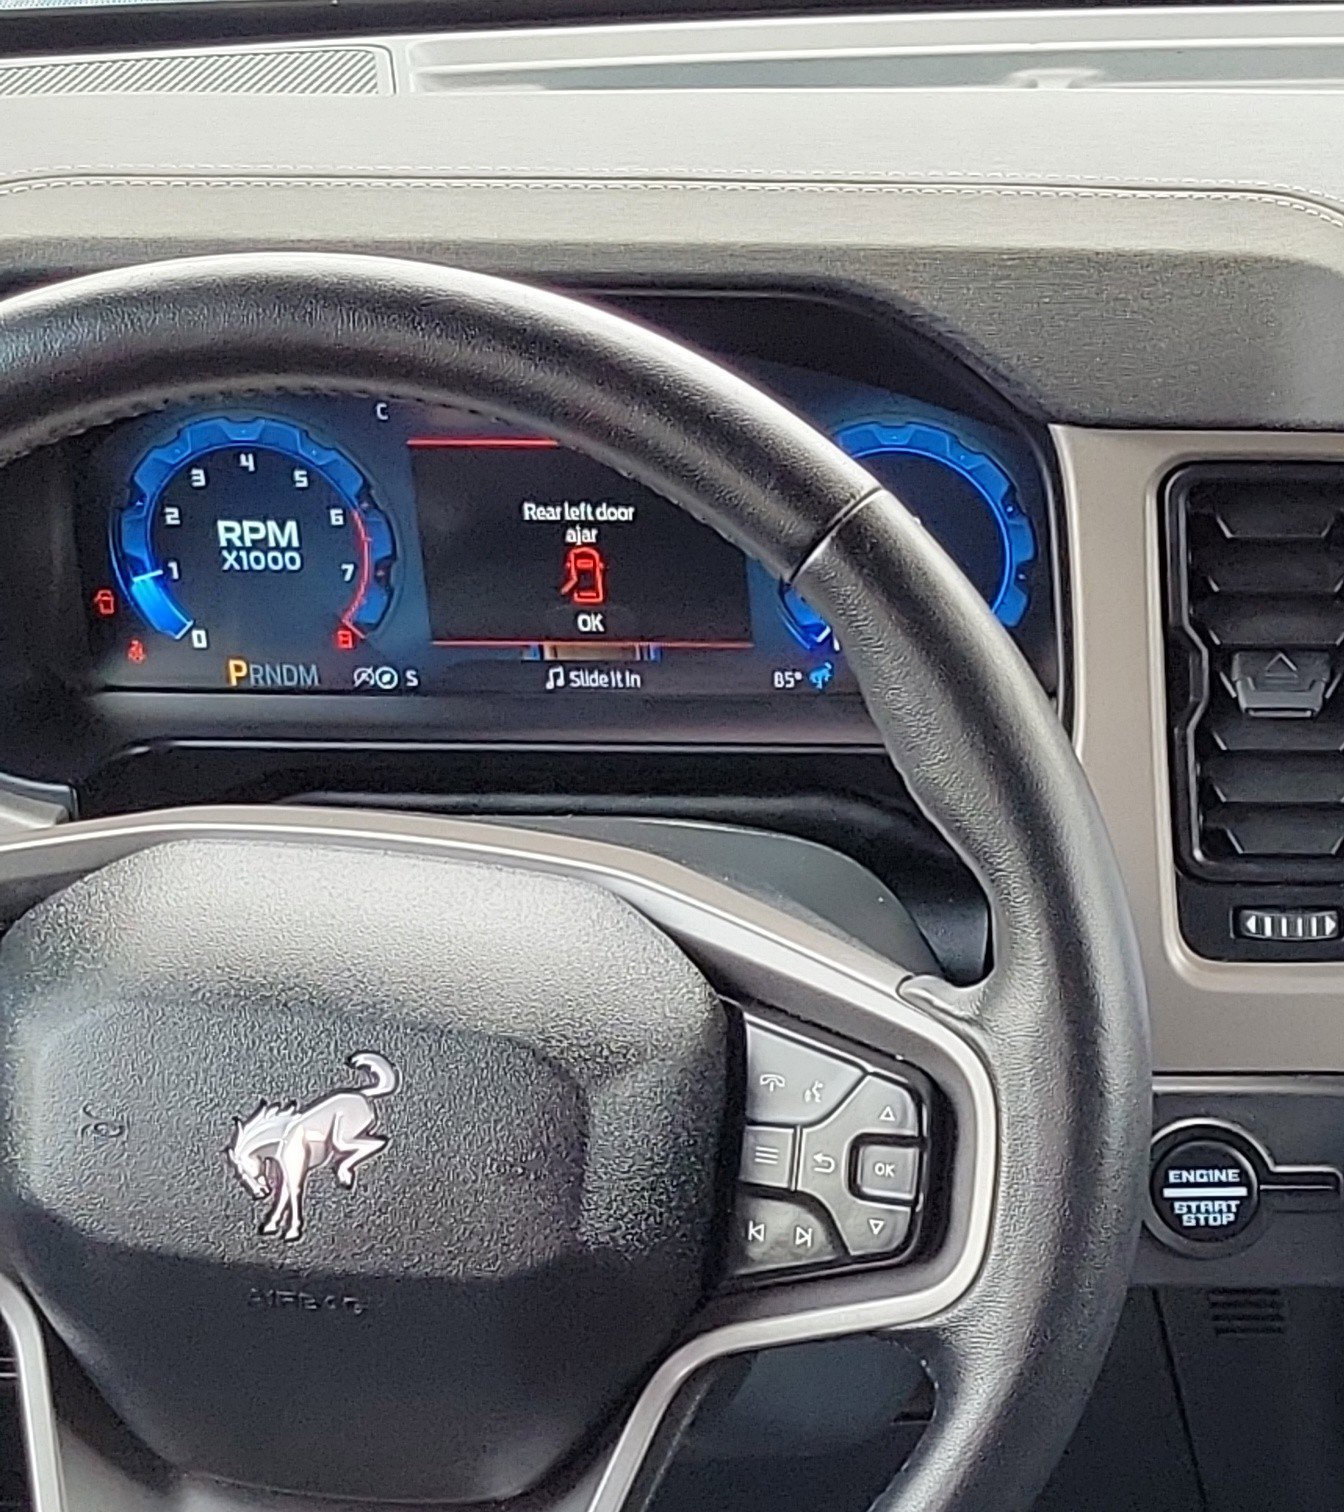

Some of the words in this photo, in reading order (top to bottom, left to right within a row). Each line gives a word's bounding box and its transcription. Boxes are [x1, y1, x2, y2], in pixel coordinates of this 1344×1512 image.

[239, 453, 255, 472] 4
[191, 469, 206, 487] 3
[293, 470, 308, 488] 5
[166, 508, 180, 525] 2
[331, 509, 344, 526] 6
[523, 501, 562, 521] Rear
[564, 501, 594, 521] left
[595, 501, 635, 521] door
[217, 519, 299, 549] RPM
[565, 524, 598, 546] ajar
[168, 561, 179, 579] 1
[221, 550, 301, 572] X1000
[341, 563, 355, 582] 7
[577, 613, 605, 632] OK
[192, 628, 207, 649] 0
[336, 630, 353, 650] 8
[569, 668, 609, 688] Slide
[610, 669, 624, 688] It
[625, 669, 641, 688] In
[874, 1162, 896, 1178] OK
[1168, 1168, 1240, 1183] ENGINE
[1173, 1200, 1240, 1213] START
[1181, 1212, 1235, 1226] STOP
